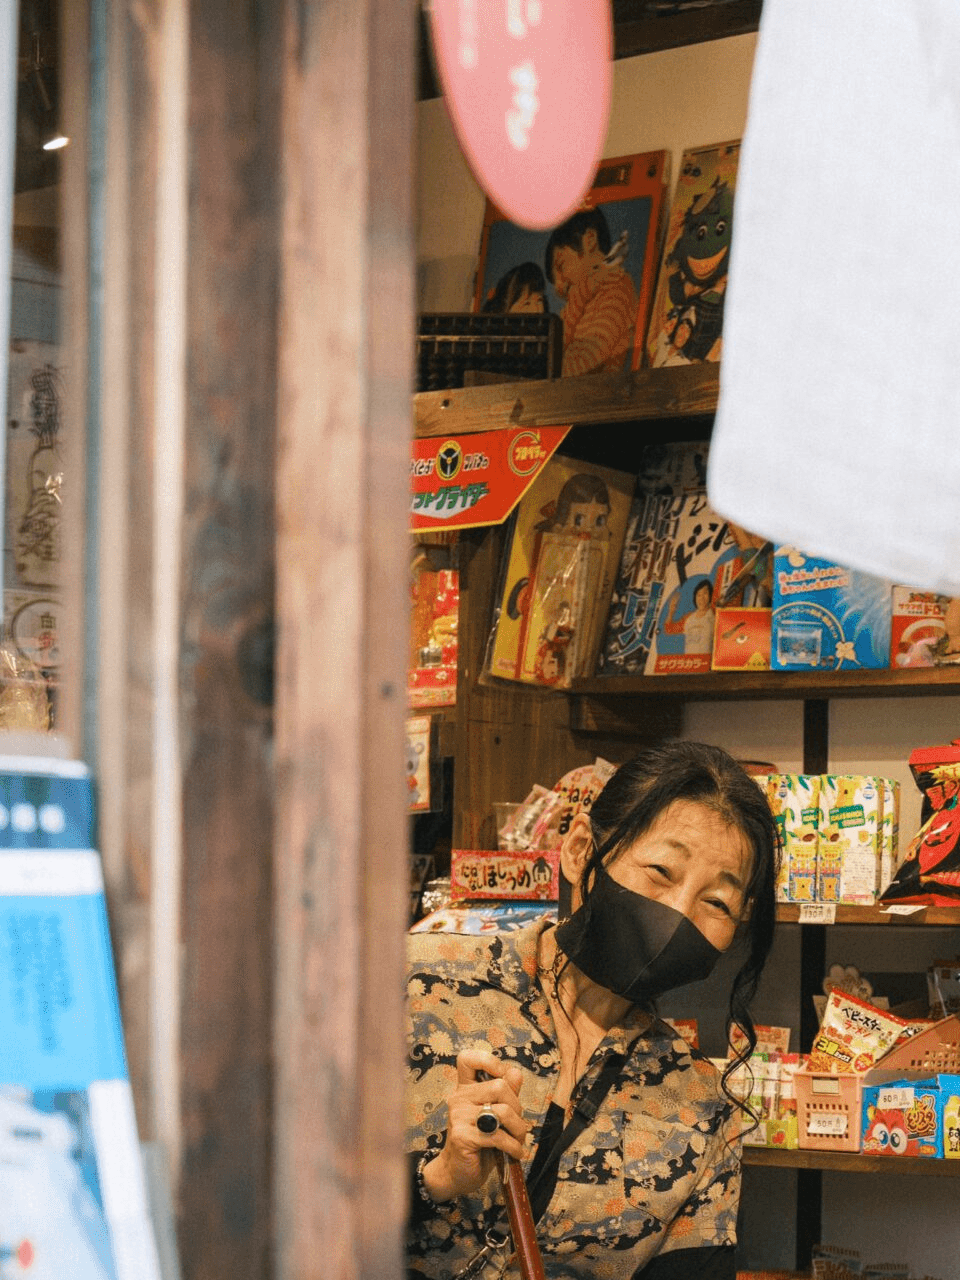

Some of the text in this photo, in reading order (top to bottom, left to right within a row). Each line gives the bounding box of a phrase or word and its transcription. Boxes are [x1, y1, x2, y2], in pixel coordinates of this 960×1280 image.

[841, 1007, 882, 1032] ベビースター
[844, 1019, 871, 1038] ラーメン
[816, 1119, 833, 1129] 50円
